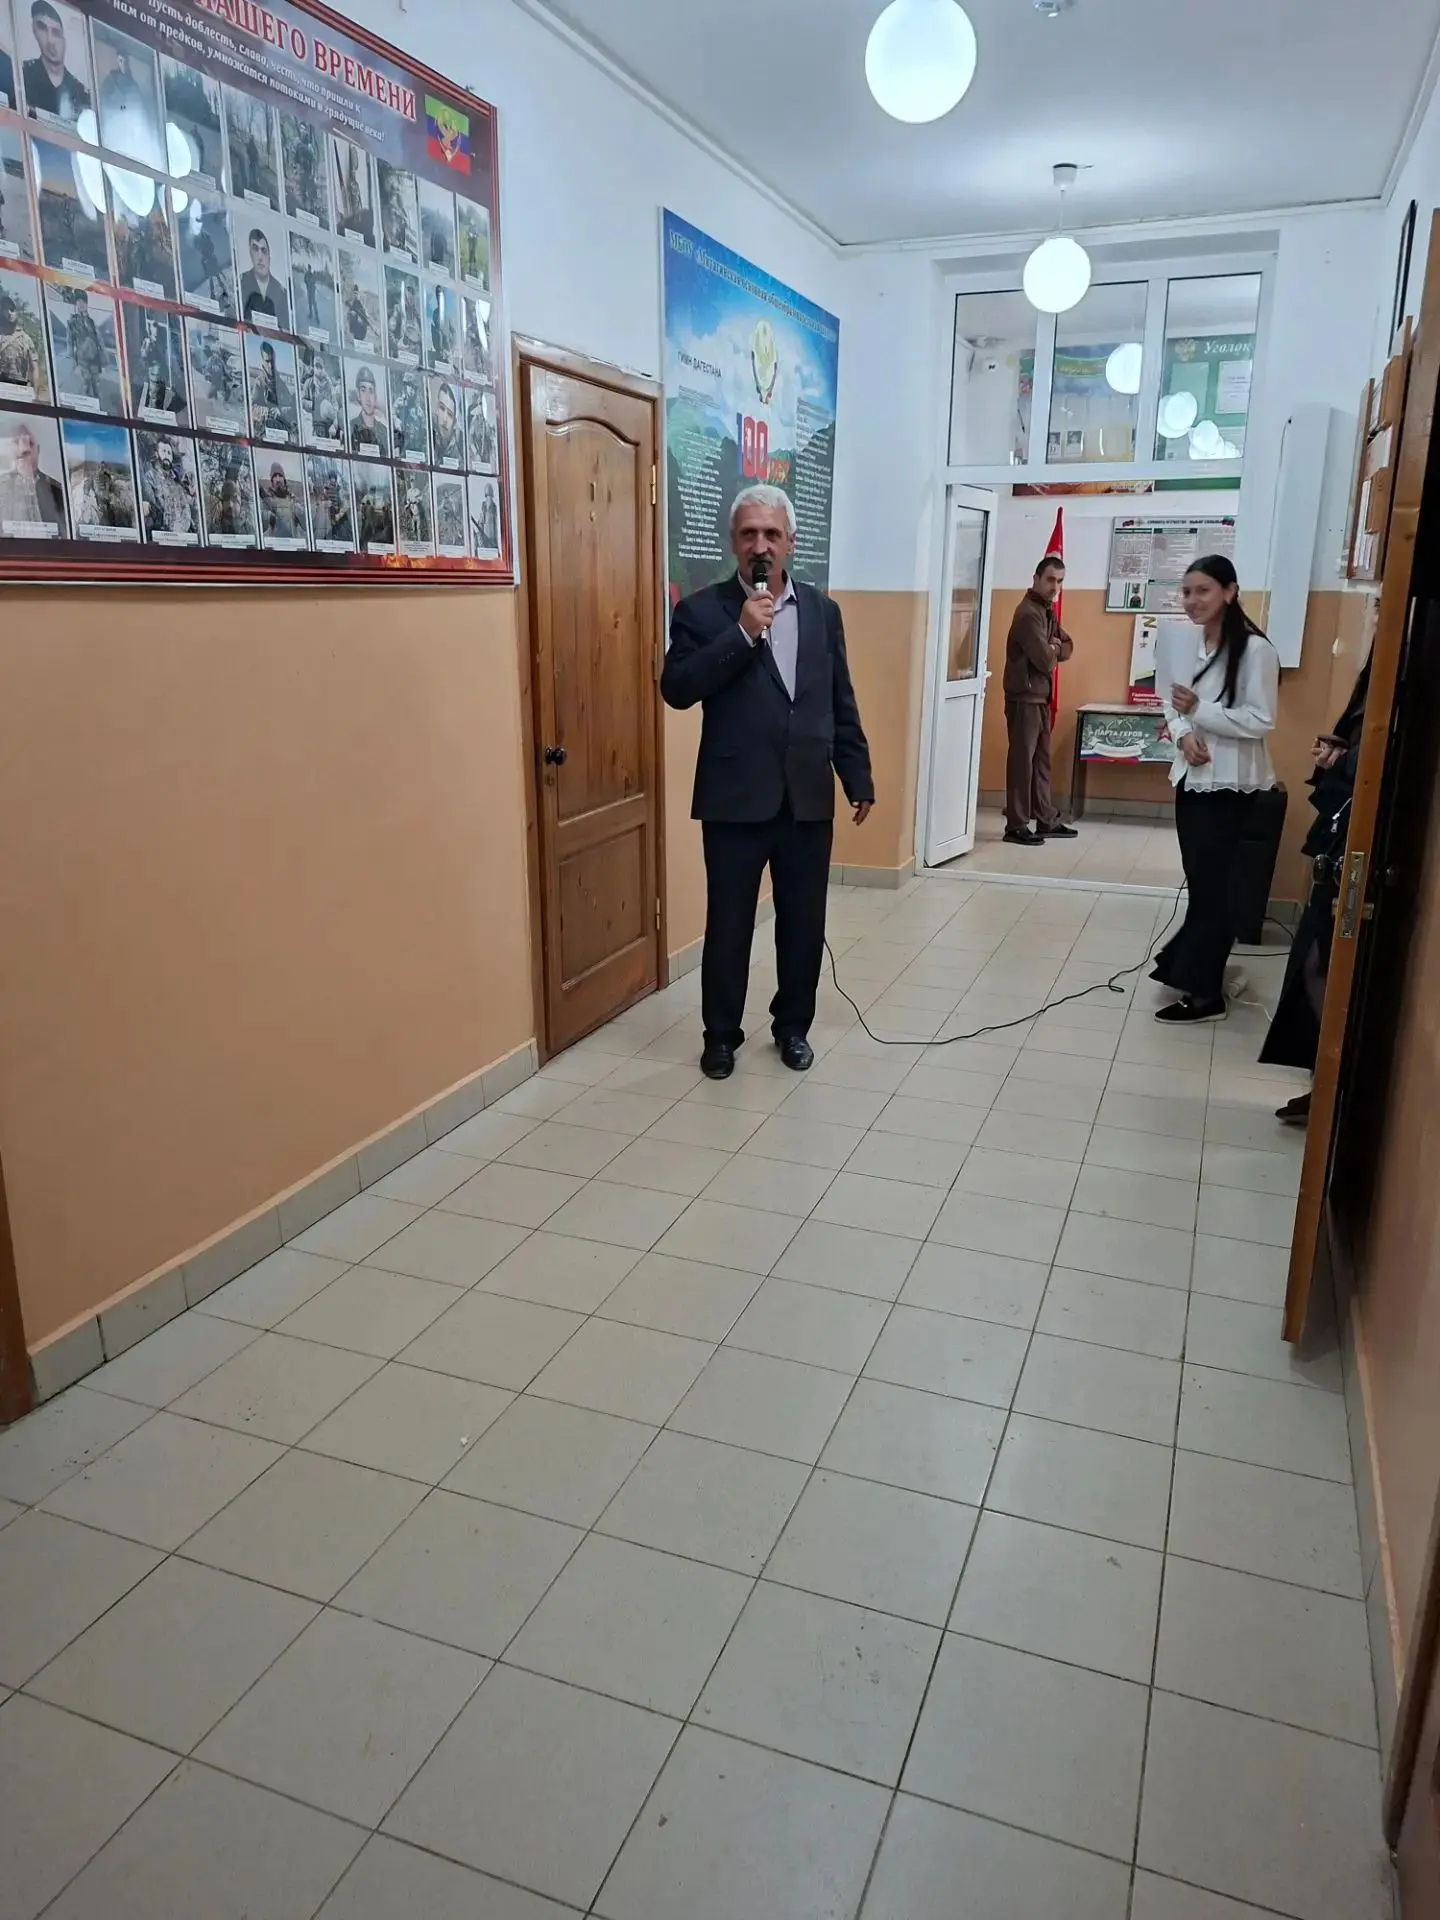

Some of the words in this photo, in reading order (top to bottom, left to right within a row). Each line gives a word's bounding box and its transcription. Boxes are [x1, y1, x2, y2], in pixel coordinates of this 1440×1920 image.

[113, 0, 137, 18] нам
[140, 12, 157, 28] от
[159, 22, 206, 55] предков,
[207, 45, 268, 84] умножатся
[269, 78, 316, 108] потоками
[317, 103, 323, 112] в
[324, 107, 364, 131] грядущие
[364, 125, 386, 142] века!
[185, 12, 237, 52] доблесть,
[239, 44, 269, 68] слава,
[270, 59, 300, 83] честь,
[300, 79, 320, 93] что
[321, 87, 353, 111] пришли
[355, 103, 361, 114] к
[312, 39, 416, 121] ВРЕМЕНИ
[693, 357, 722, 378] ДАГЕСТАНА
[1203, 340, 1252, 355] Уголок
[736, 411, 768, 480] 100
[1094, 728, 1118, 737] ПАРТА
